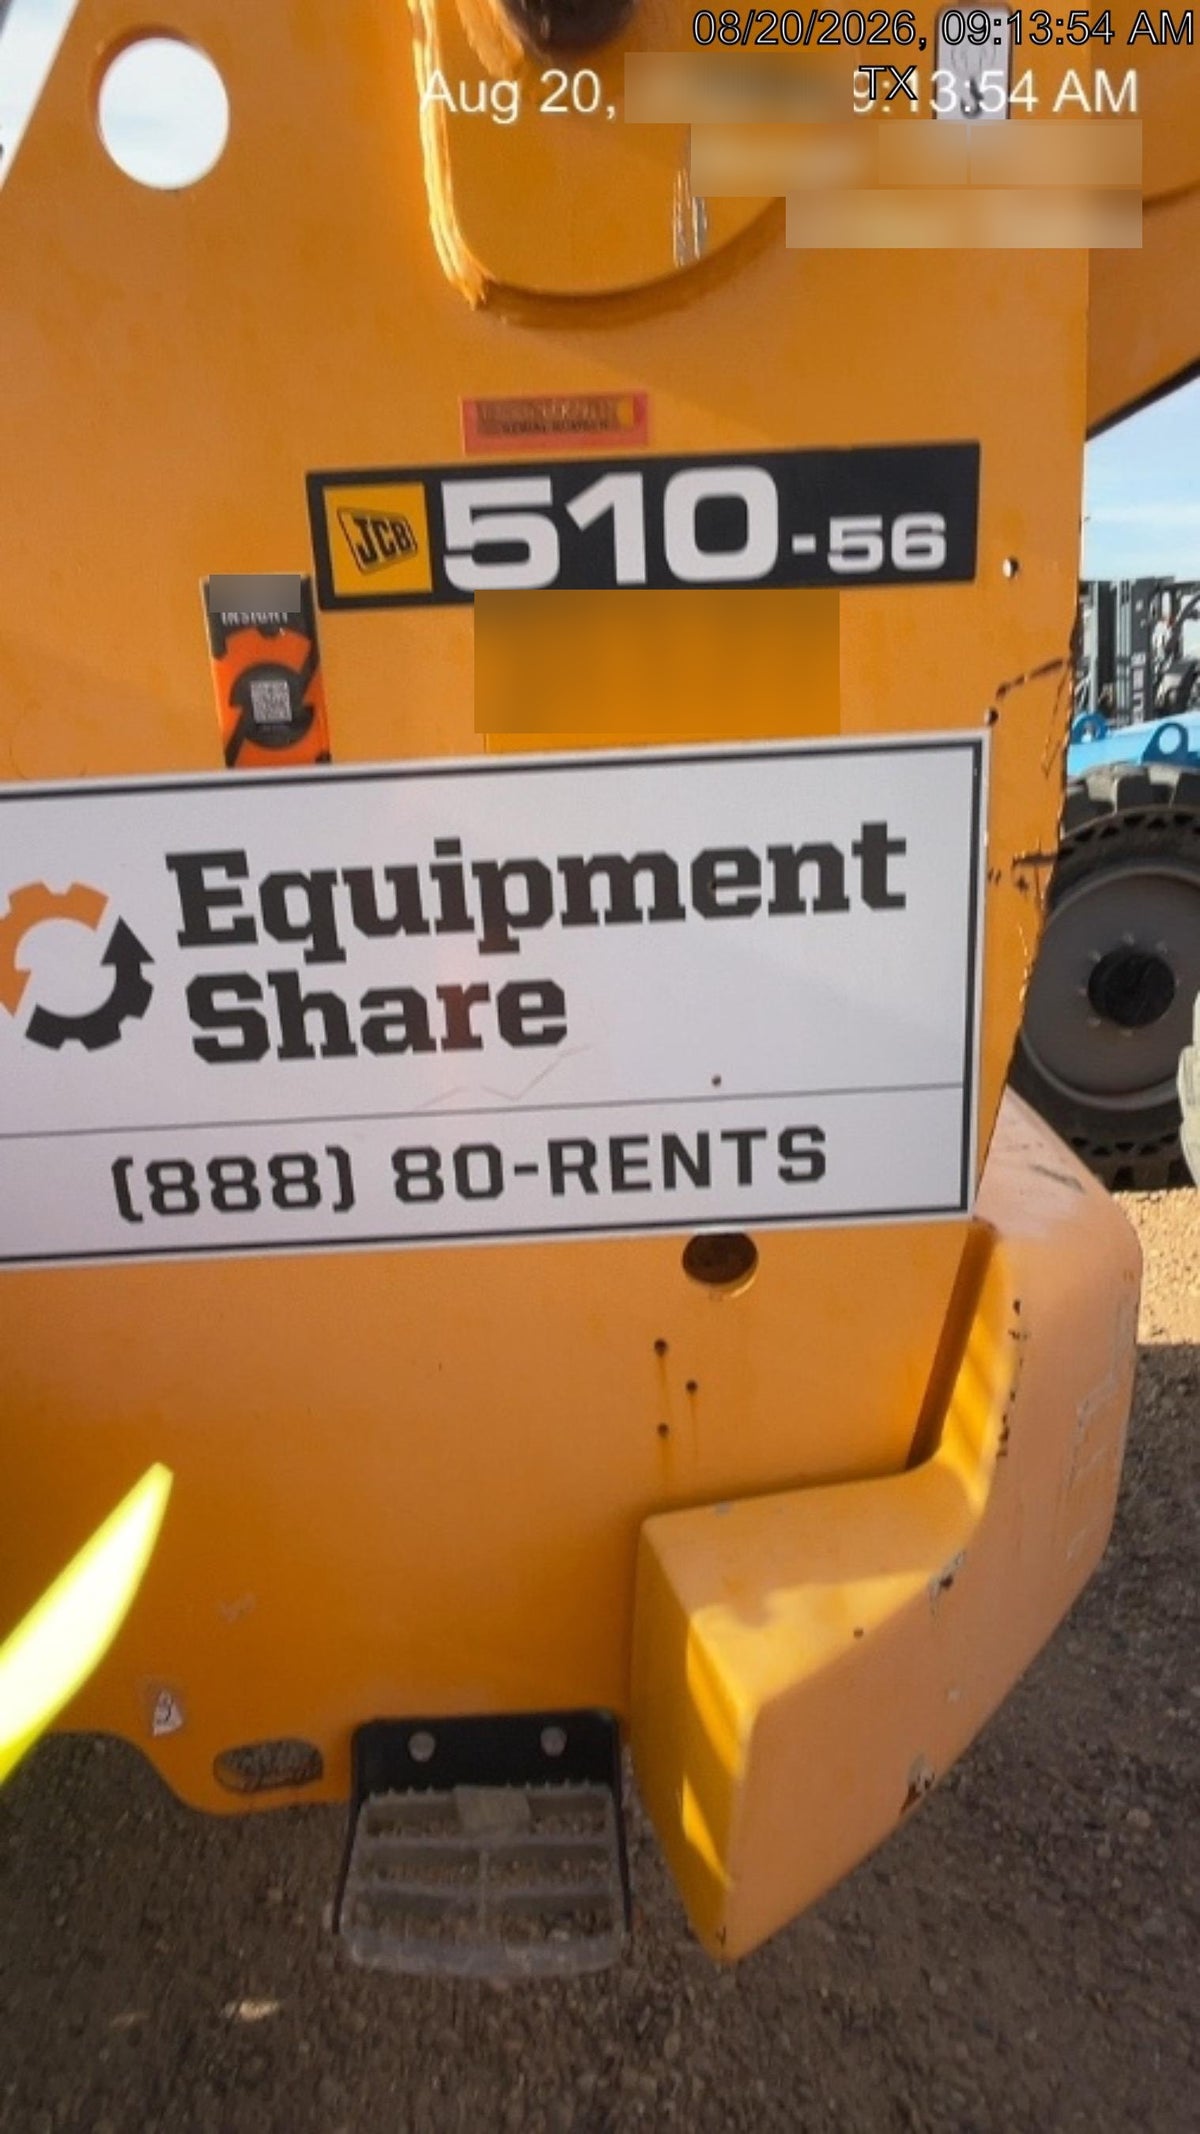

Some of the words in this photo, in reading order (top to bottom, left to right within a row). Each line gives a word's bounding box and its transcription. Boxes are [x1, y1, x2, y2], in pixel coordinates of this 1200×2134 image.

[440, 464, 947, 592] 510-56
[166, 821, 906, 964] Equipment
[186, 970, 567, 1063] Share
[112, 1146, 354, 1223] (888)
[391, 1126, 826, 1203] 80-RENTS
